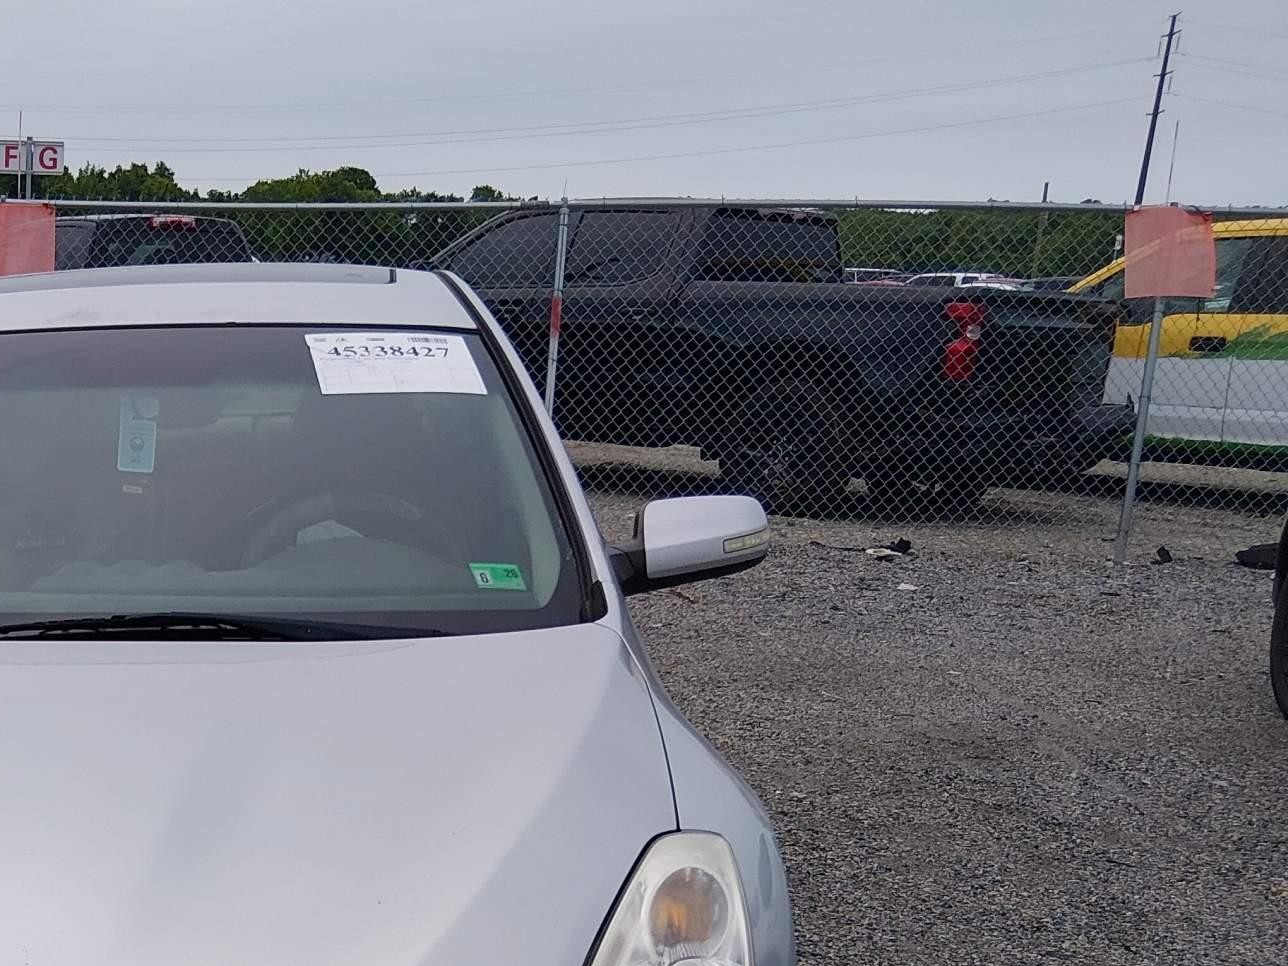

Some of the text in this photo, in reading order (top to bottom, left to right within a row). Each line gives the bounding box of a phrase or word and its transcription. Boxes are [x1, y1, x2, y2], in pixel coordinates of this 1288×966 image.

[4, 145, 58, 170] F G
[327, 345, 449, 359] 45338427
